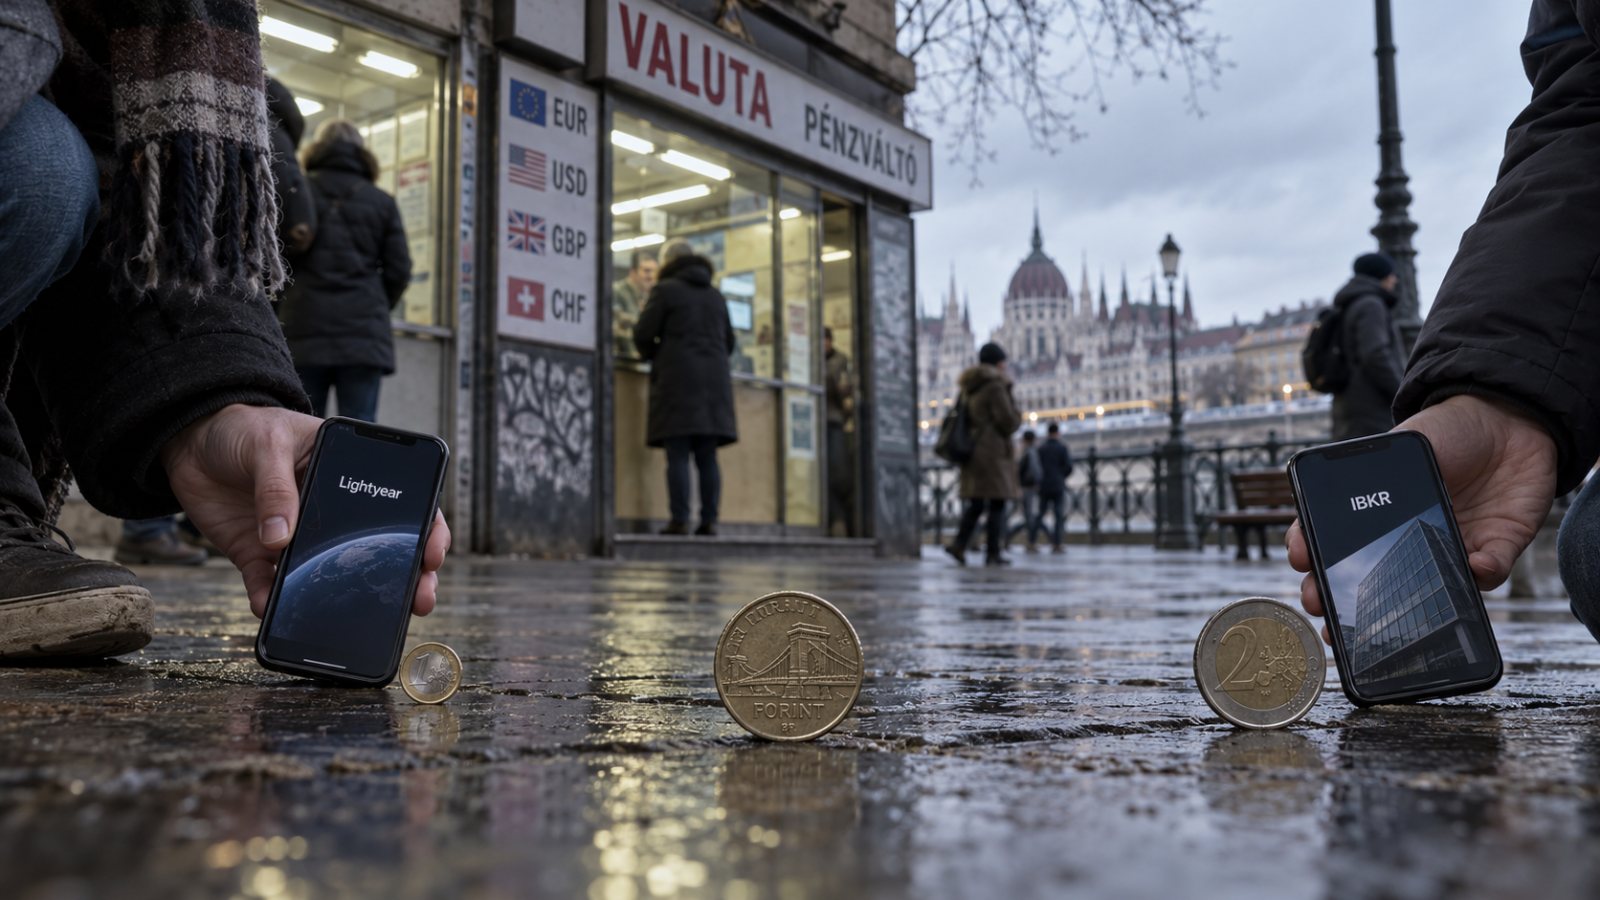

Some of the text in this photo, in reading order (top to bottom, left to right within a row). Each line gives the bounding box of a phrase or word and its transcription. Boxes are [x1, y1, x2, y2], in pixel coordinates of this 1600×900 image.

[619, 3, 918, 187] VALUTA PÉNZVÁLTÓ
[552, 96, 588, 137] EUR
[552, 160, 588, 197] USD
[551, 225, 587, 260] GBP
[551, 289, 586, 324] CHF
[339, 475, 403, 499] Lightyear
[1350, 491, 1392, 511] IBKR
[408, 652, 430, 686] 1
[1214, 624, 1257, 692] 2
[753, 702, 825, 719] FORINT
